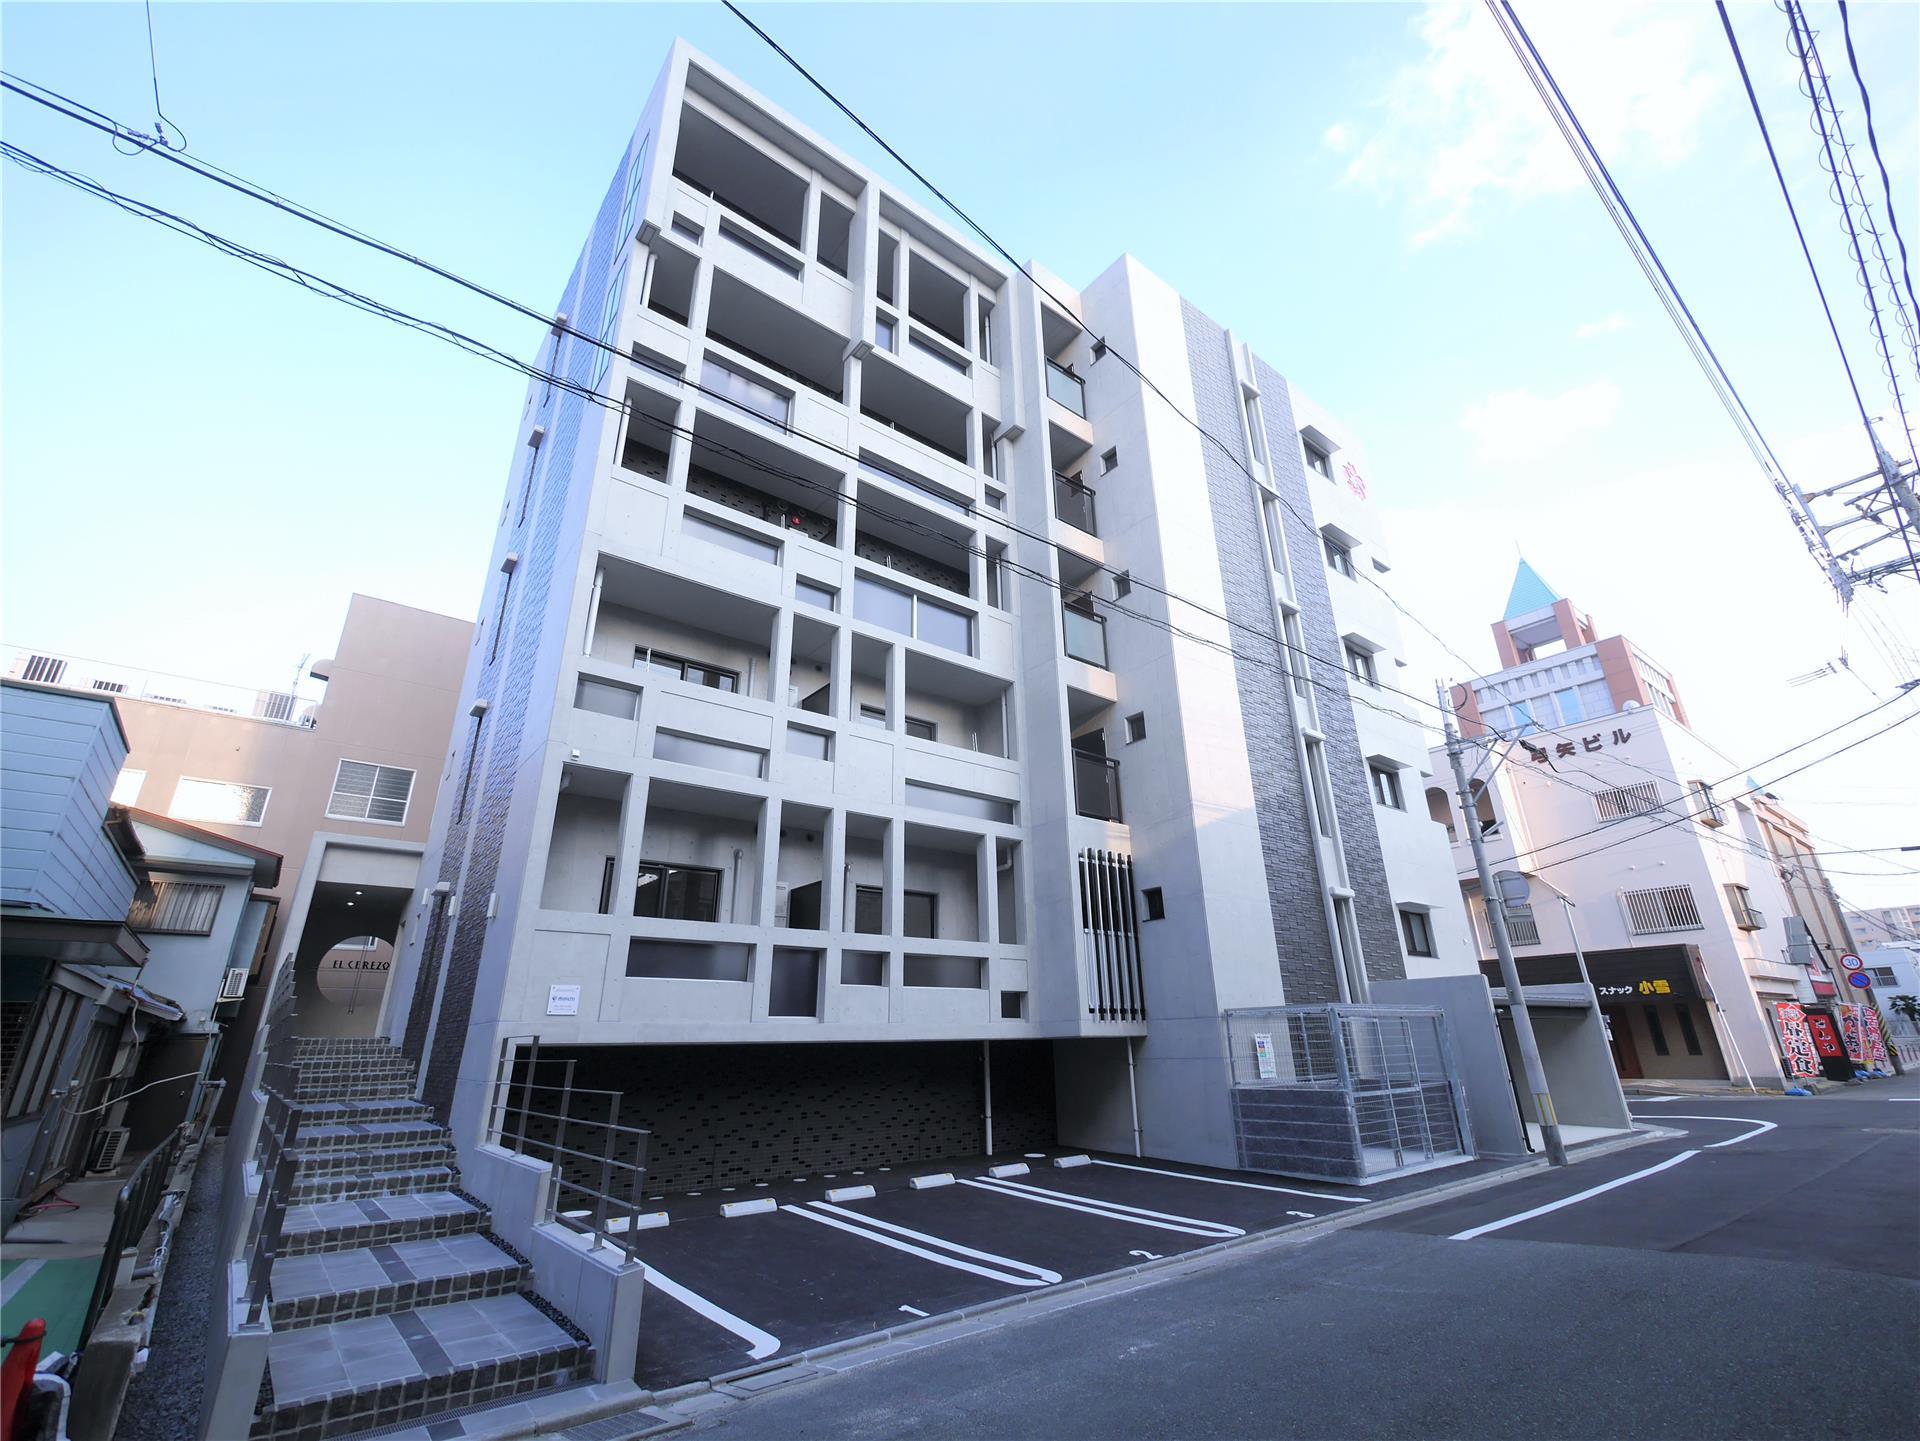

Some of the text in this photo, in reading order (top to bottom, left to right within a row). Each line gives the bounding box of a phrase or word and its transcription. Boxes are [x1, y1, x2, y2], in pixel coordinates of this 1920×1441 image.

[332, 959, 391, 970] EL CEREZO
[1845, 958, 1859, 967] 30
[1599, 985, 1633, 996] スナック
[1129, 1249, 1164, 1260] 2
